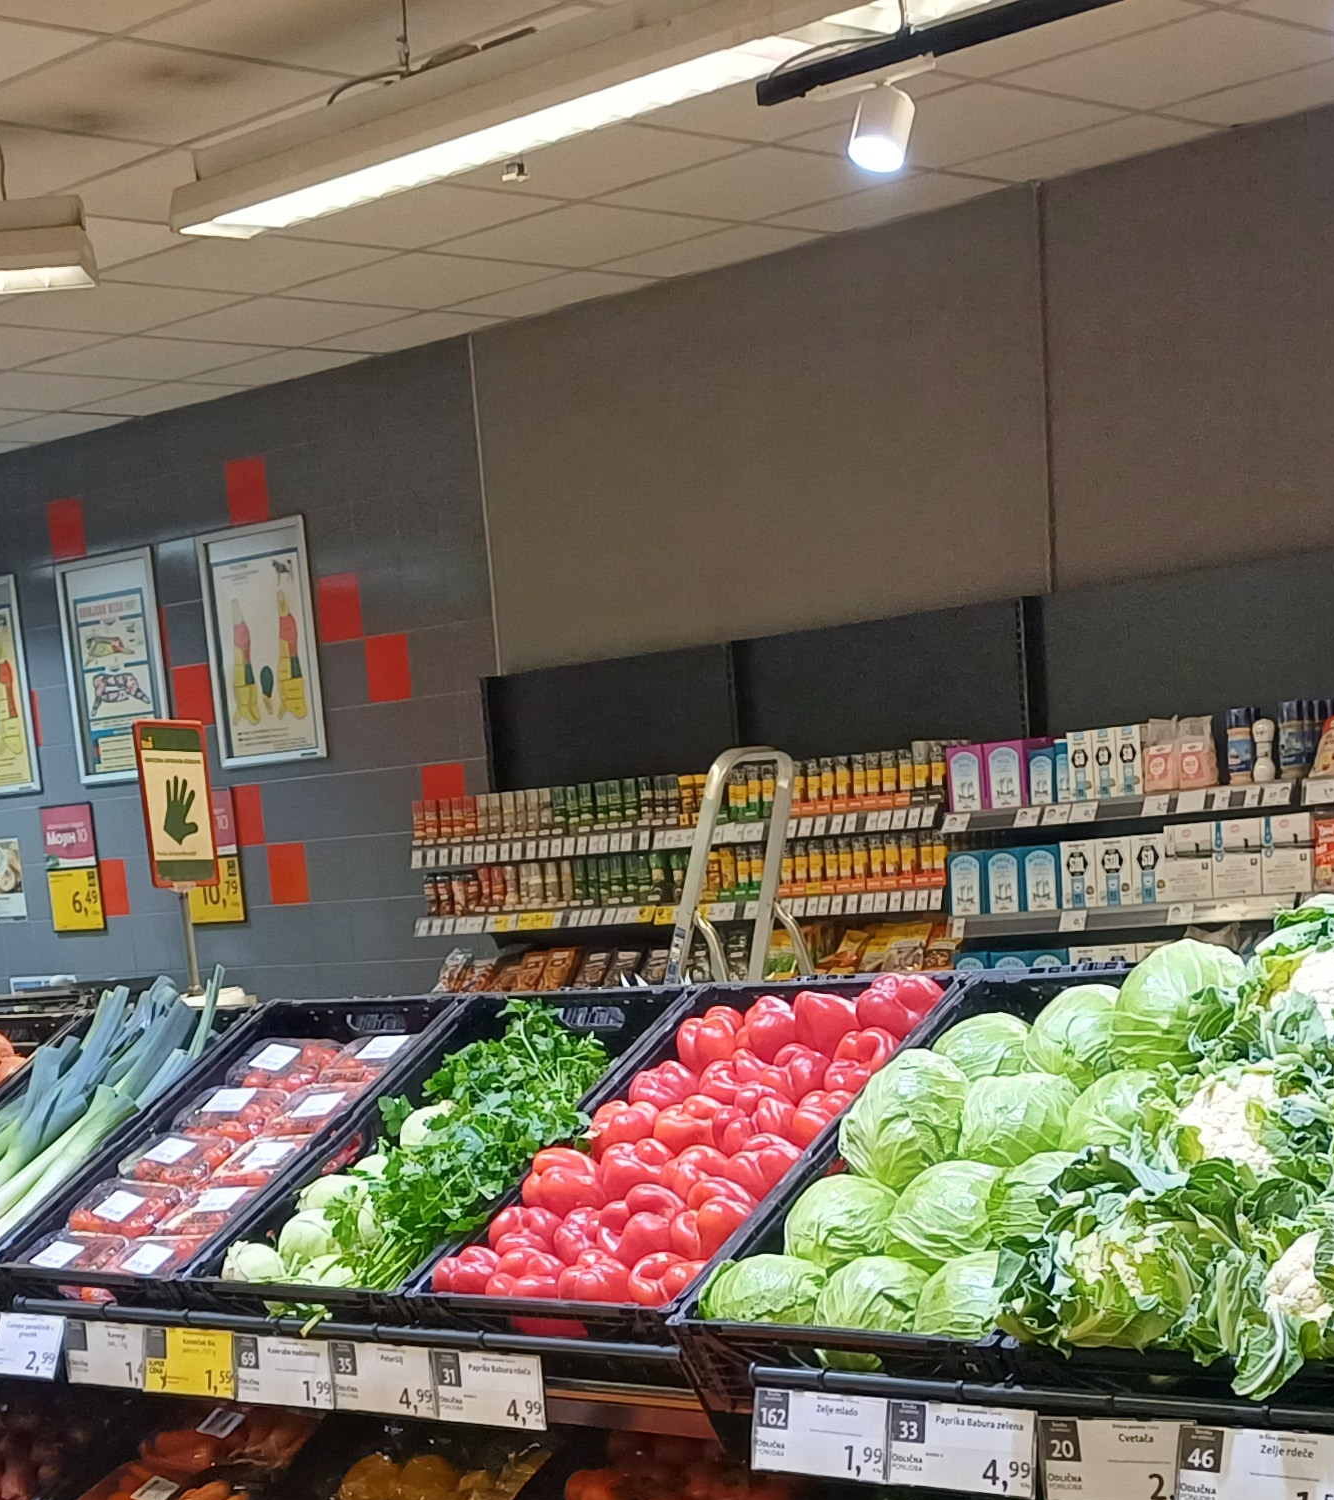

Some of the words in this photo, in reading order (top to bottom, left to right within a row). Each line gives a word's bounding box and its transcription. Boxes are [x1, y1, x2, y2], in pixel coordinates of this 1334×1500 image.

[25, 1350, 56, 1374] 2,99
[240, 1351, 256, 1367] 69
[337, 1357, 352, 1373] 35
[442, 1367, 456, 1385] 31
[302, 1380, 331, 1406] 1,99
[399, 1387, 432, 1415] 4,99
[506, 1398, 542, 1427] 4,99
[760, 1406, 786, 1427] 162
[816, 1404, 833, 1416] Zelje
[835, 1407, 858, 1417] mlado
[899, 1420, 918, 1440] 33
[935, 1415, 965, 1427] Paprika
[966, 1418, 995, 1429] Babura
[996, 1420, 1024, 1432] zelena
[1118, 1433, 1155, 1444] Cvetača
[1050, 1439, 1075, 1459] 20
[1187, 1447, 1215, 1469] 46
[1260, 1444, 1285, 1458] Zelje
[1286, 1445, 1314, 1459] rdeče
[844, 1445, 883, 1477] 1,99
[982, 1459, 1031, 1493] 4,99
[1179, 1482, 1217, 1496] ODLIČNA
